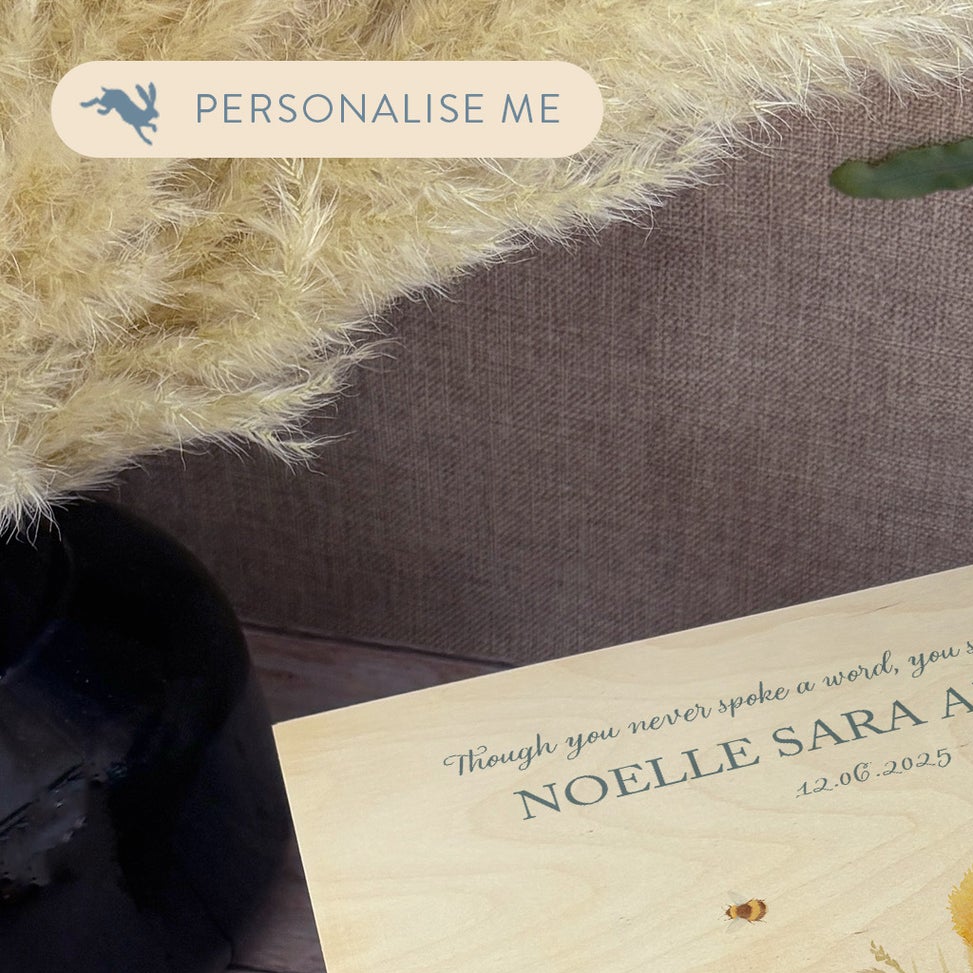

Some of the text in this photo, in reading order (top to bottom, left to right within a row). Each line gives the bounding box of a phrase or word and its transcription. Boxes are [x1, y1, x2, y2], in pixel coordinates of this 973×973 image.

[443, 733, 558, 776] Though
[566, 726, 620, 760] you
[627, 704, 712, 734] never
[718, 680, 790, 718] spoke
[796, 680, 816, 695] a
[823, 650, 899, 688] word,
[908, 646, 961, 678] you
[513, 737, 760, 820] NOELLE
[772, 699, 928, 759] SARA
[795, 748, 952, 798] 12.06.2025
